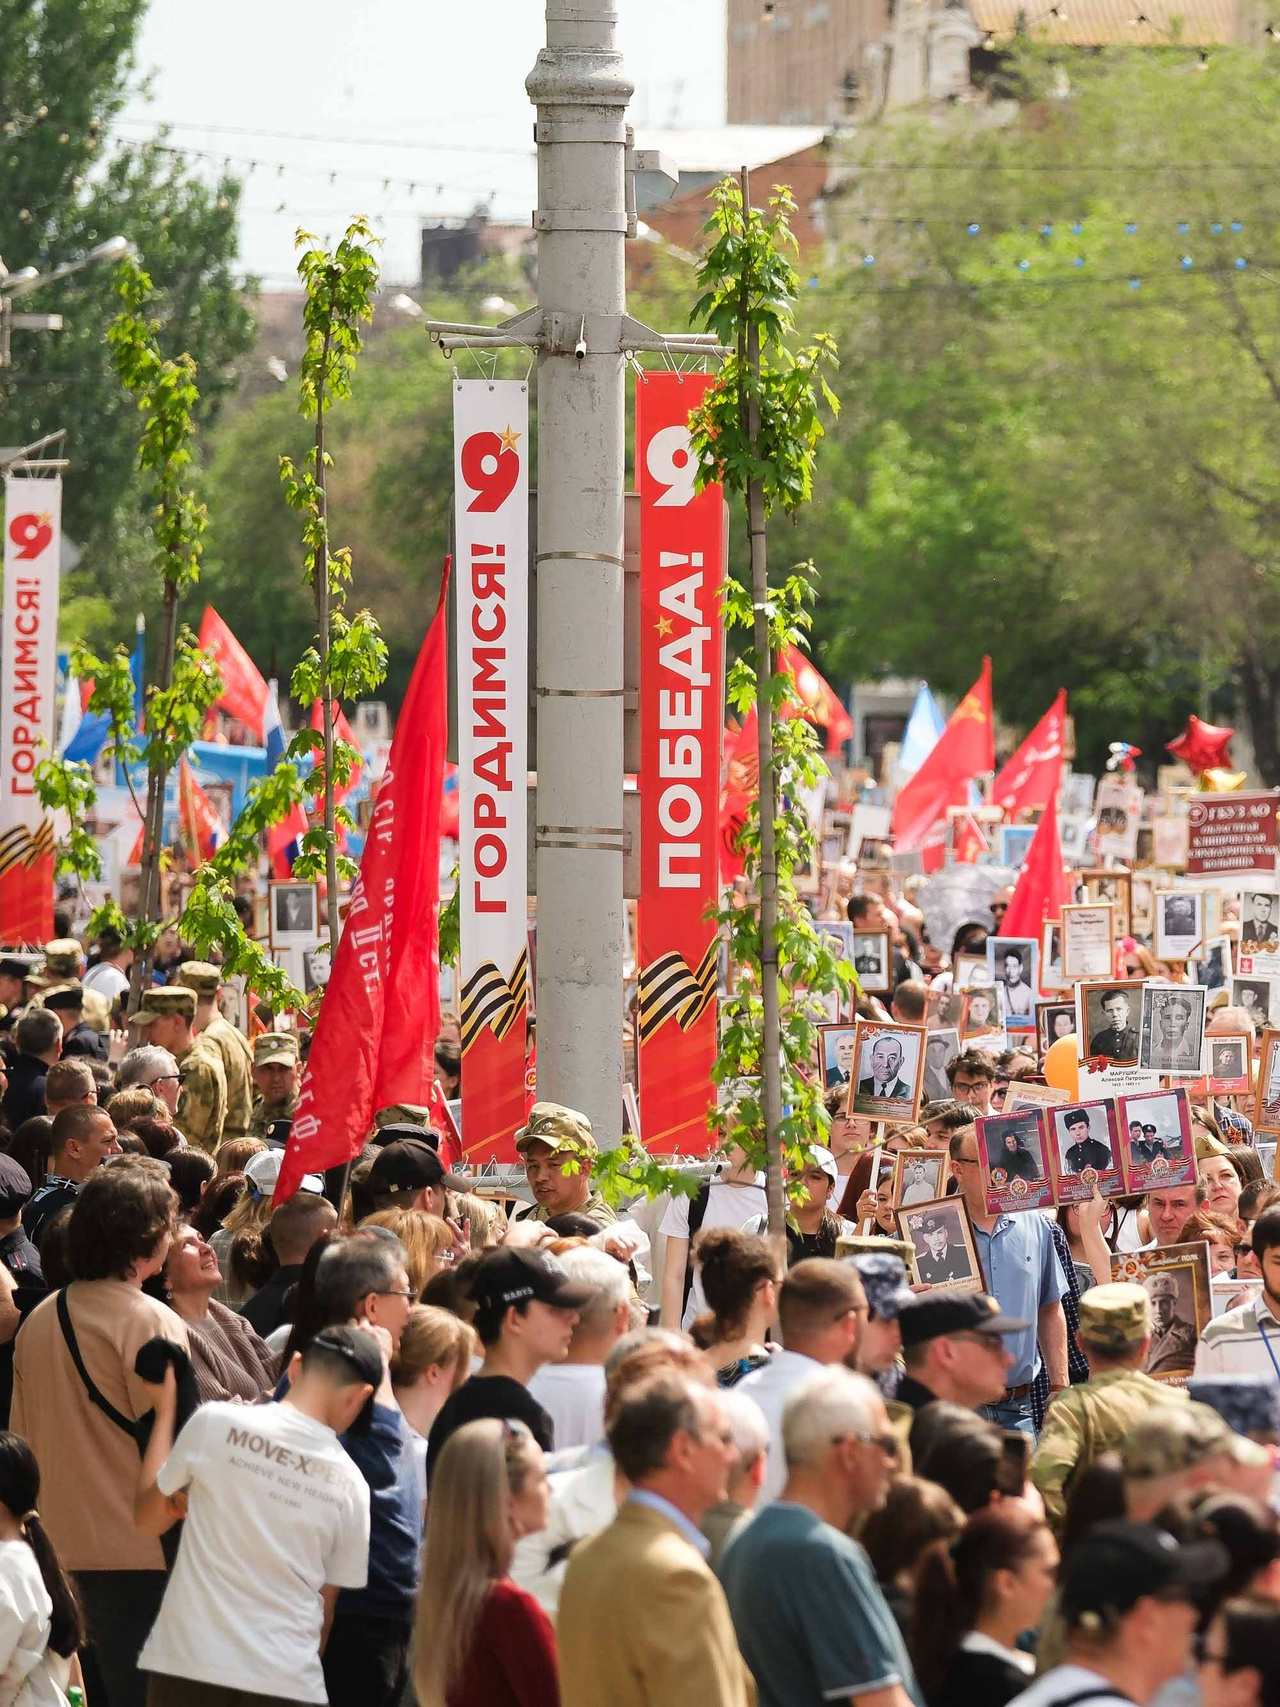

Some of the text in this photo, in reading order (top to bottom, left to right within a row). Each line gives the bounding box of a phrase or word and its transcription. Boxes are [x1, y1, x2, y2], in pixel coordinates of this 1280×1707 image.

[11, 577, 42, 797] ГОРДИМСЯ!
[471, 542, 512, 914] ГОРДИМСЯ!
[658, 550, 712, 889] ПОБЕДА!
[229, 1457, 274, 1480] ACHIEVE
[278, 1476, 300, 1491] NEW
